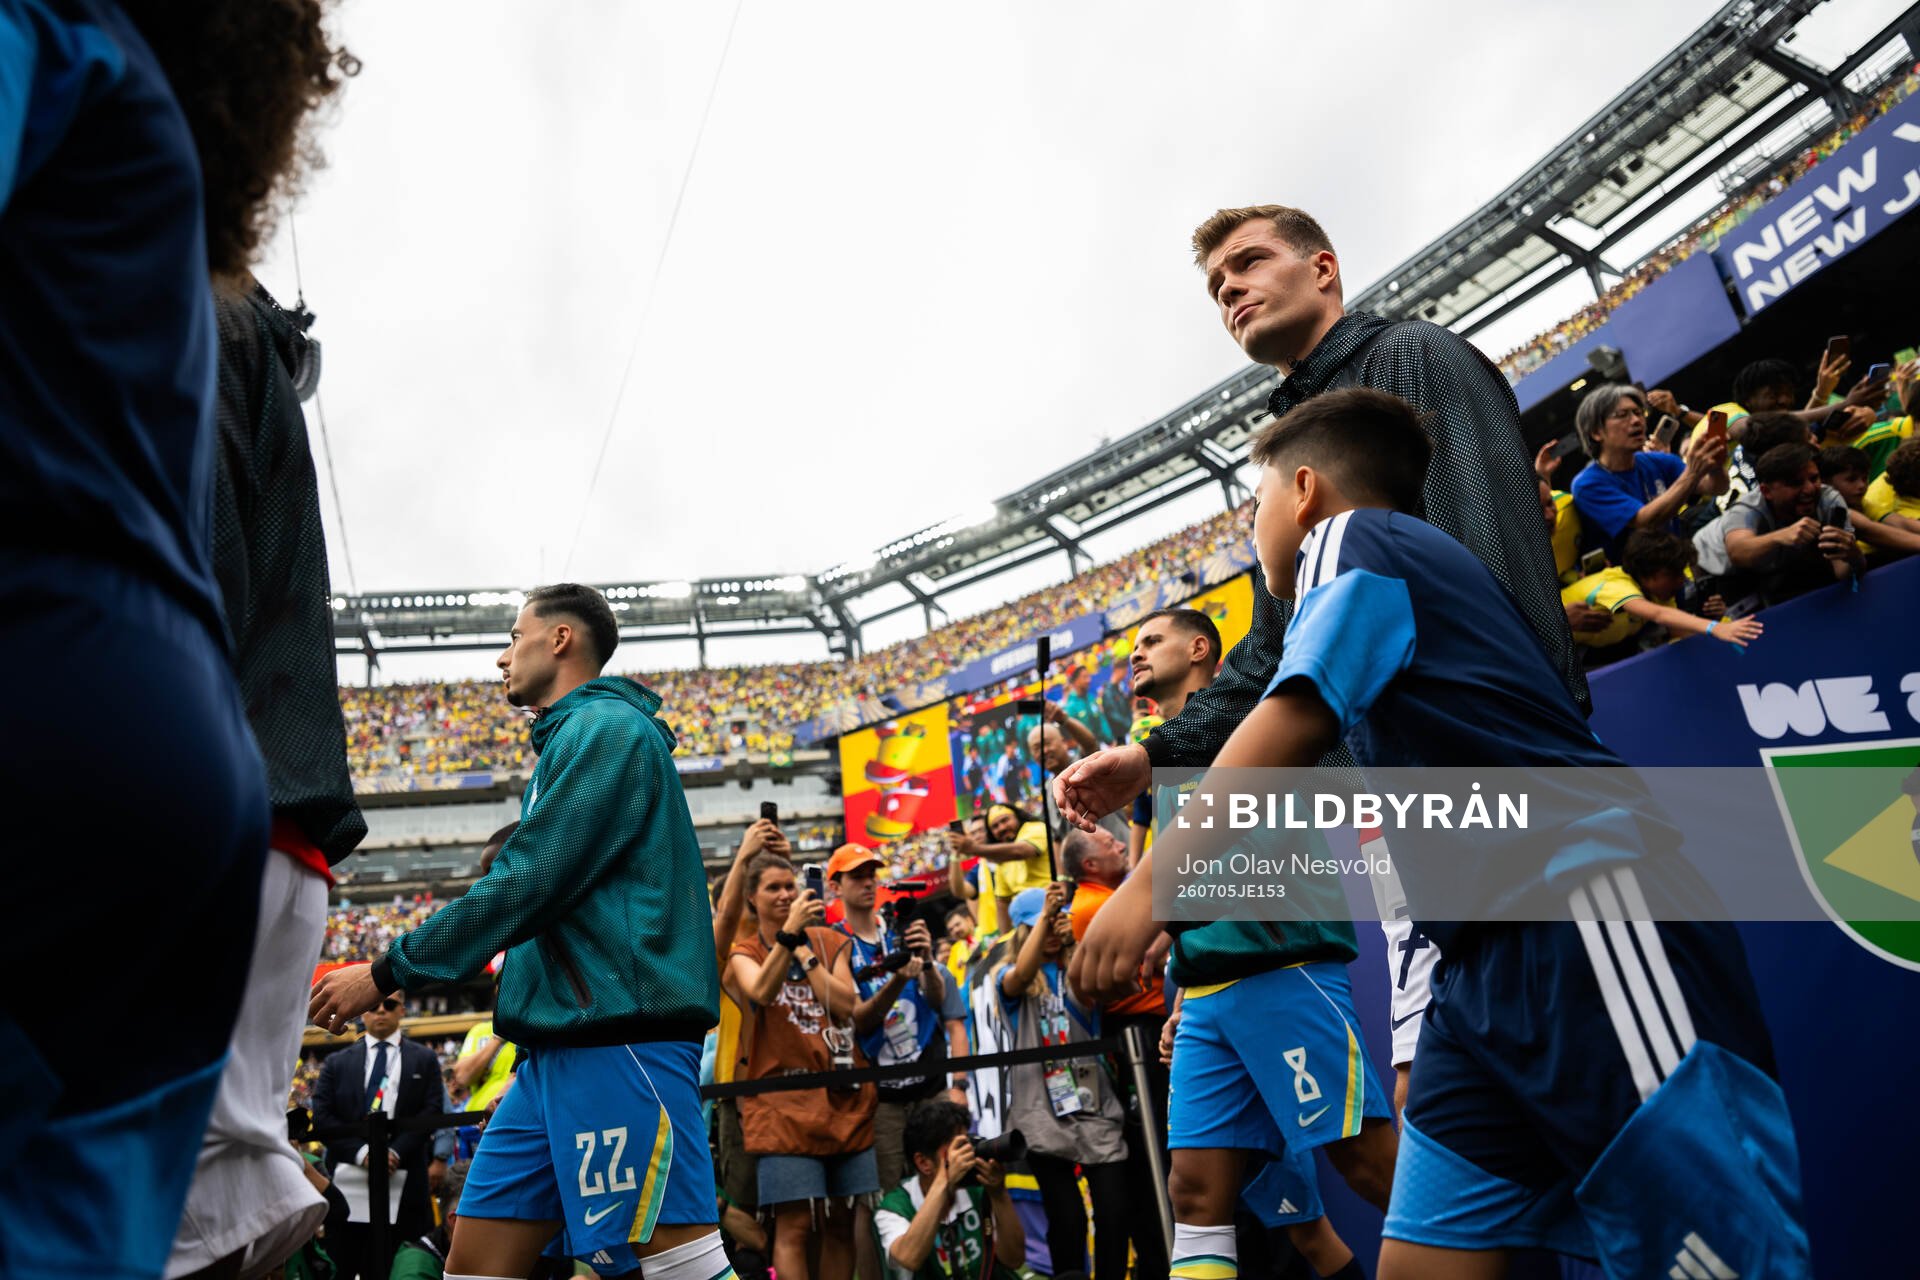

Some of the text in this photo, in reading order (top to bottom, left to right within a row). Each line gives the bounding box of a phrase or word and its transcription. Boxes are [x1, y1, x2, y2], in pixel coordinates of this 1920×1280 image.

[1732, 146, 1878, 280] NEW
[1746, 205, 1867, 312] NEW
[1736, 675, 1892, 740] WE
[1282, 1046, 1322, 1104] 8
[575, 1126, 637, 1197] 22
